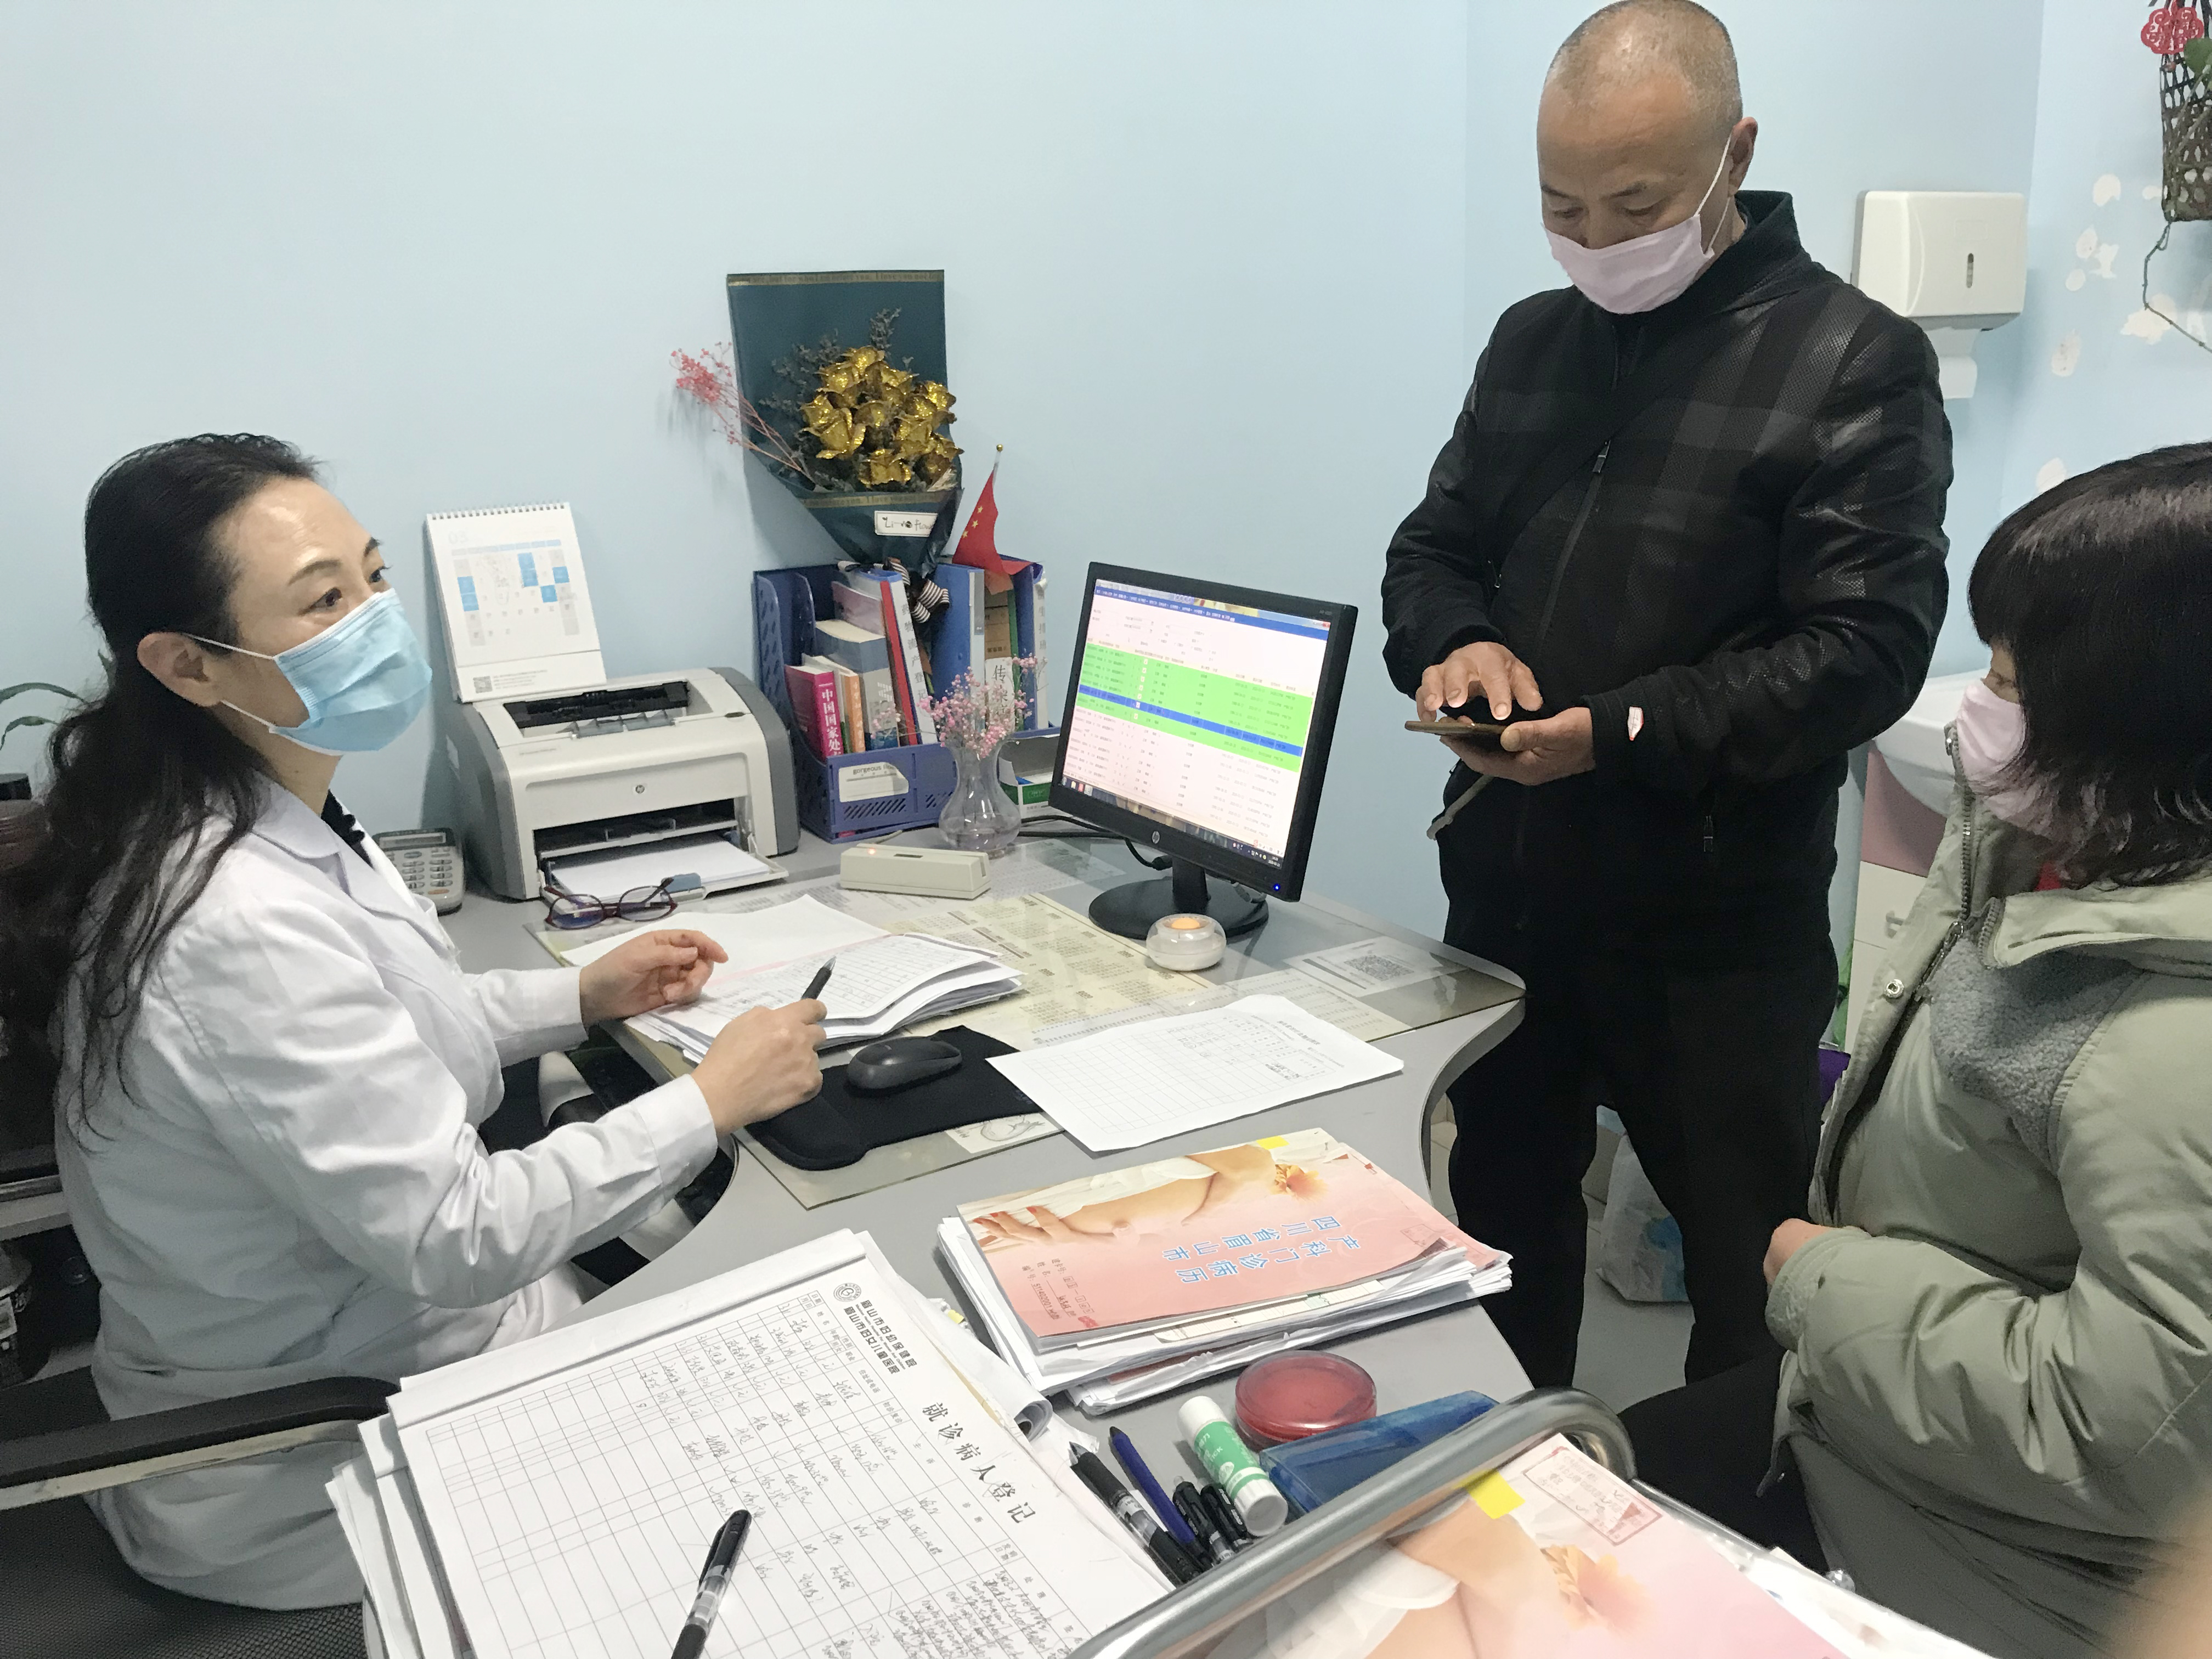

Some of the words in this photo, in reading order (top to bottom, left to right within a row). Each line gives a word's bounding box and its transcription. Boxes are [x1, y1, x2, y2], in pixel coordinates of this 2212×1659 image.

[853, 766, 882, 775] gorgeous
[1161, 1215, 1342, 1262] 四川省眉山市
[1175, 1234, 1362, 1283] 产科门诊病历
[1033, 1283, 1053, 1309] 511402001
[843, 1306, 900, 1374] 眉山市妇女儿童医院
[860, 1300, 917, 1368] 眉山市妇幼保健院
[921, 1402, 1036, 1523] 就诊病人登记
